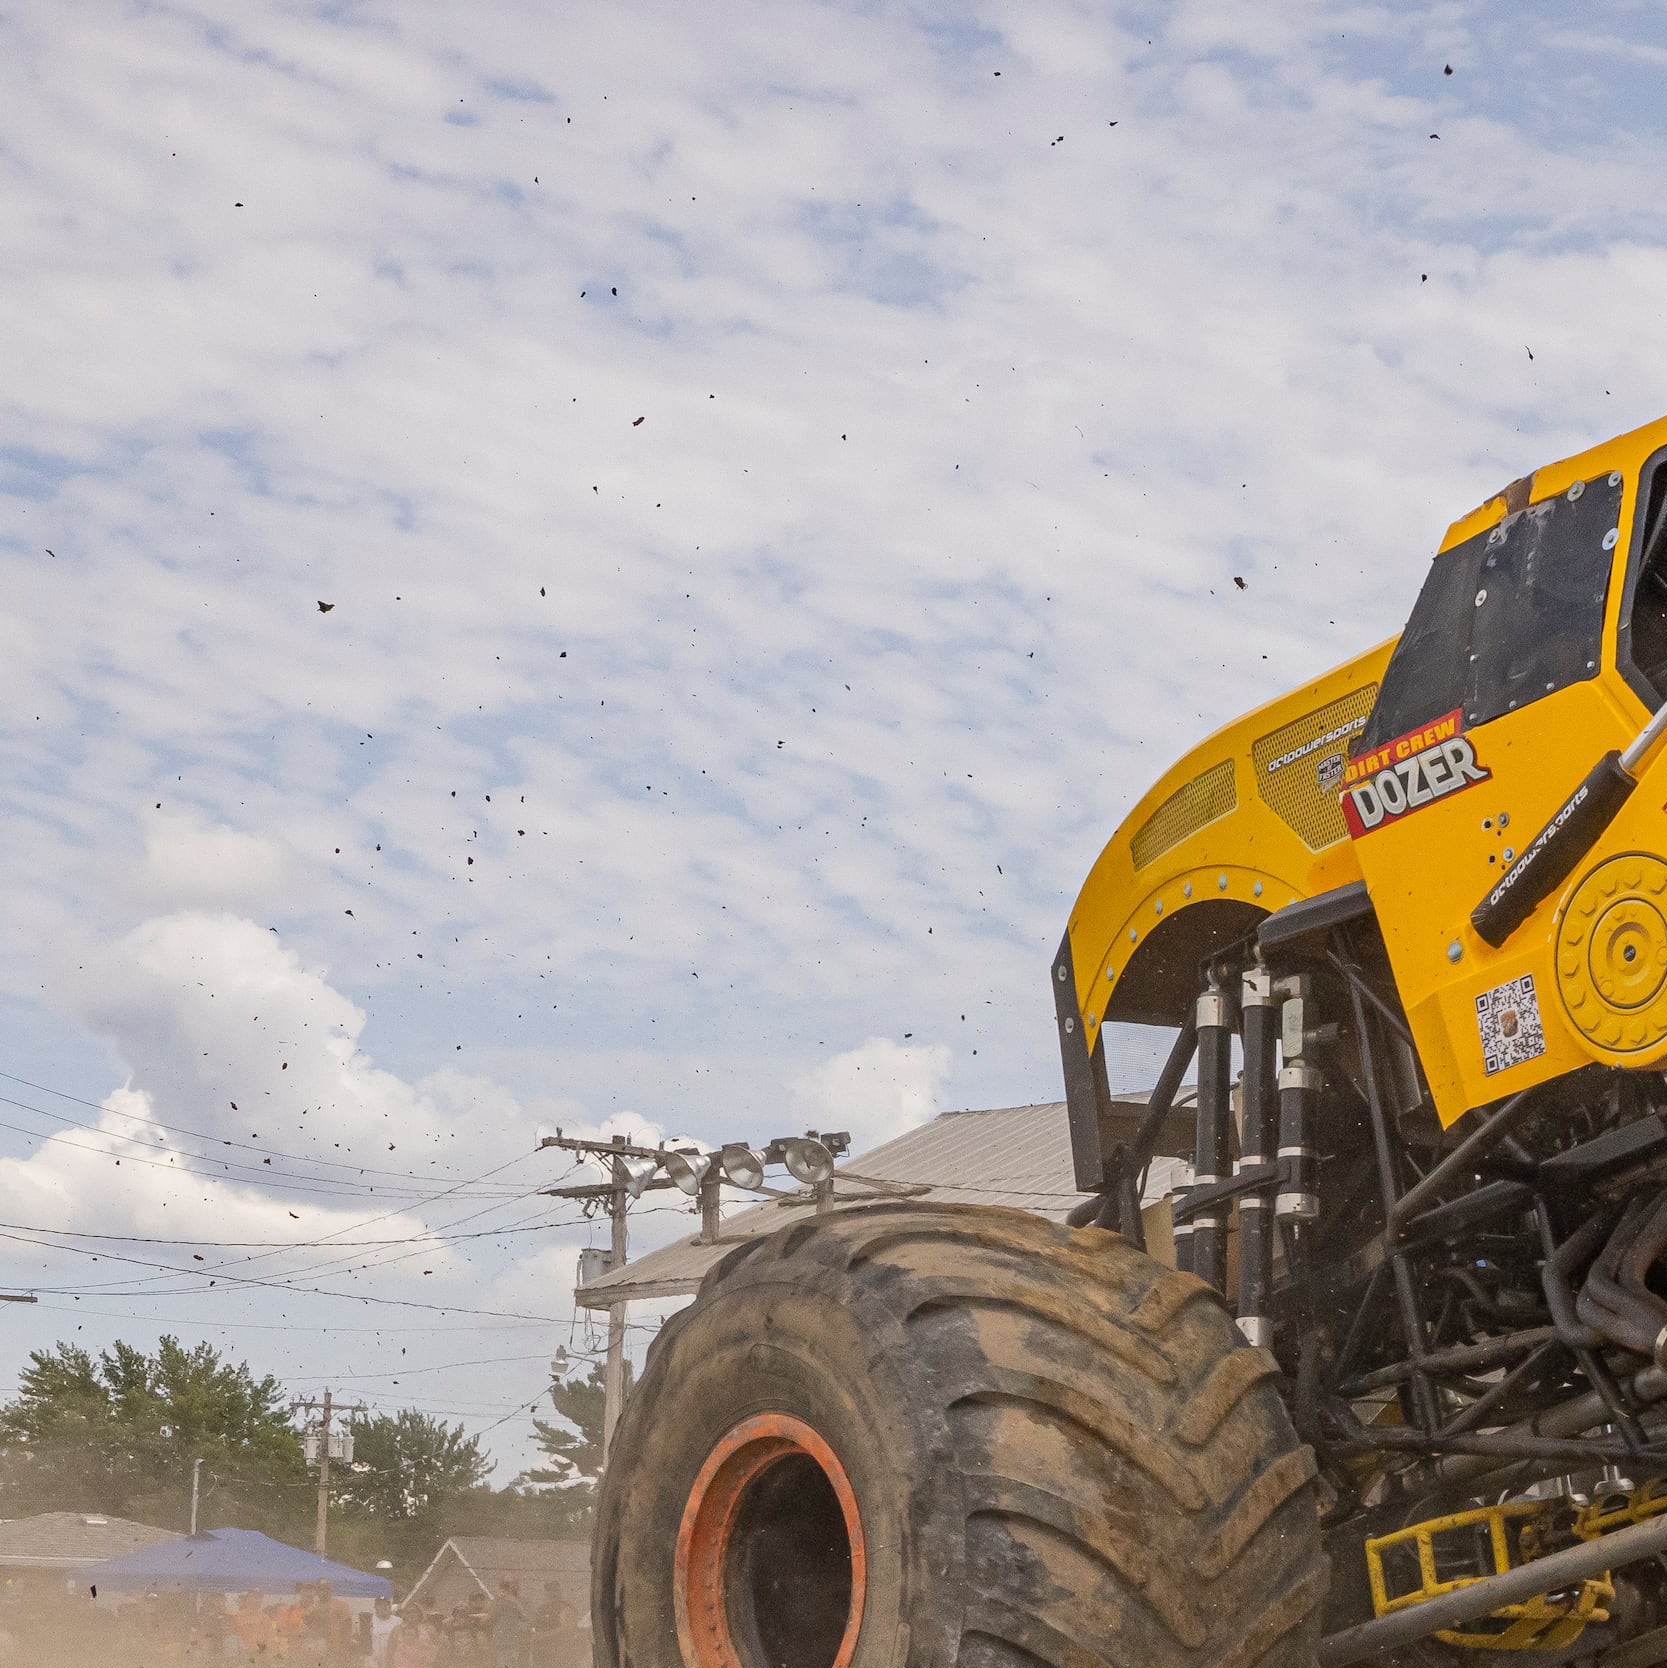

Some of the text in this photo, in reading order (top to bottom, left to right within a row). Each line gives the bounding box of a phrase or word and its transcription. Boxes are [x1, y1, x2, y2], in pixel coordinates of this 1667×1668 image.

[1345, 717, 1455, 783] DIRT CREW
[1351, 737, 1489, 829] DOZER
